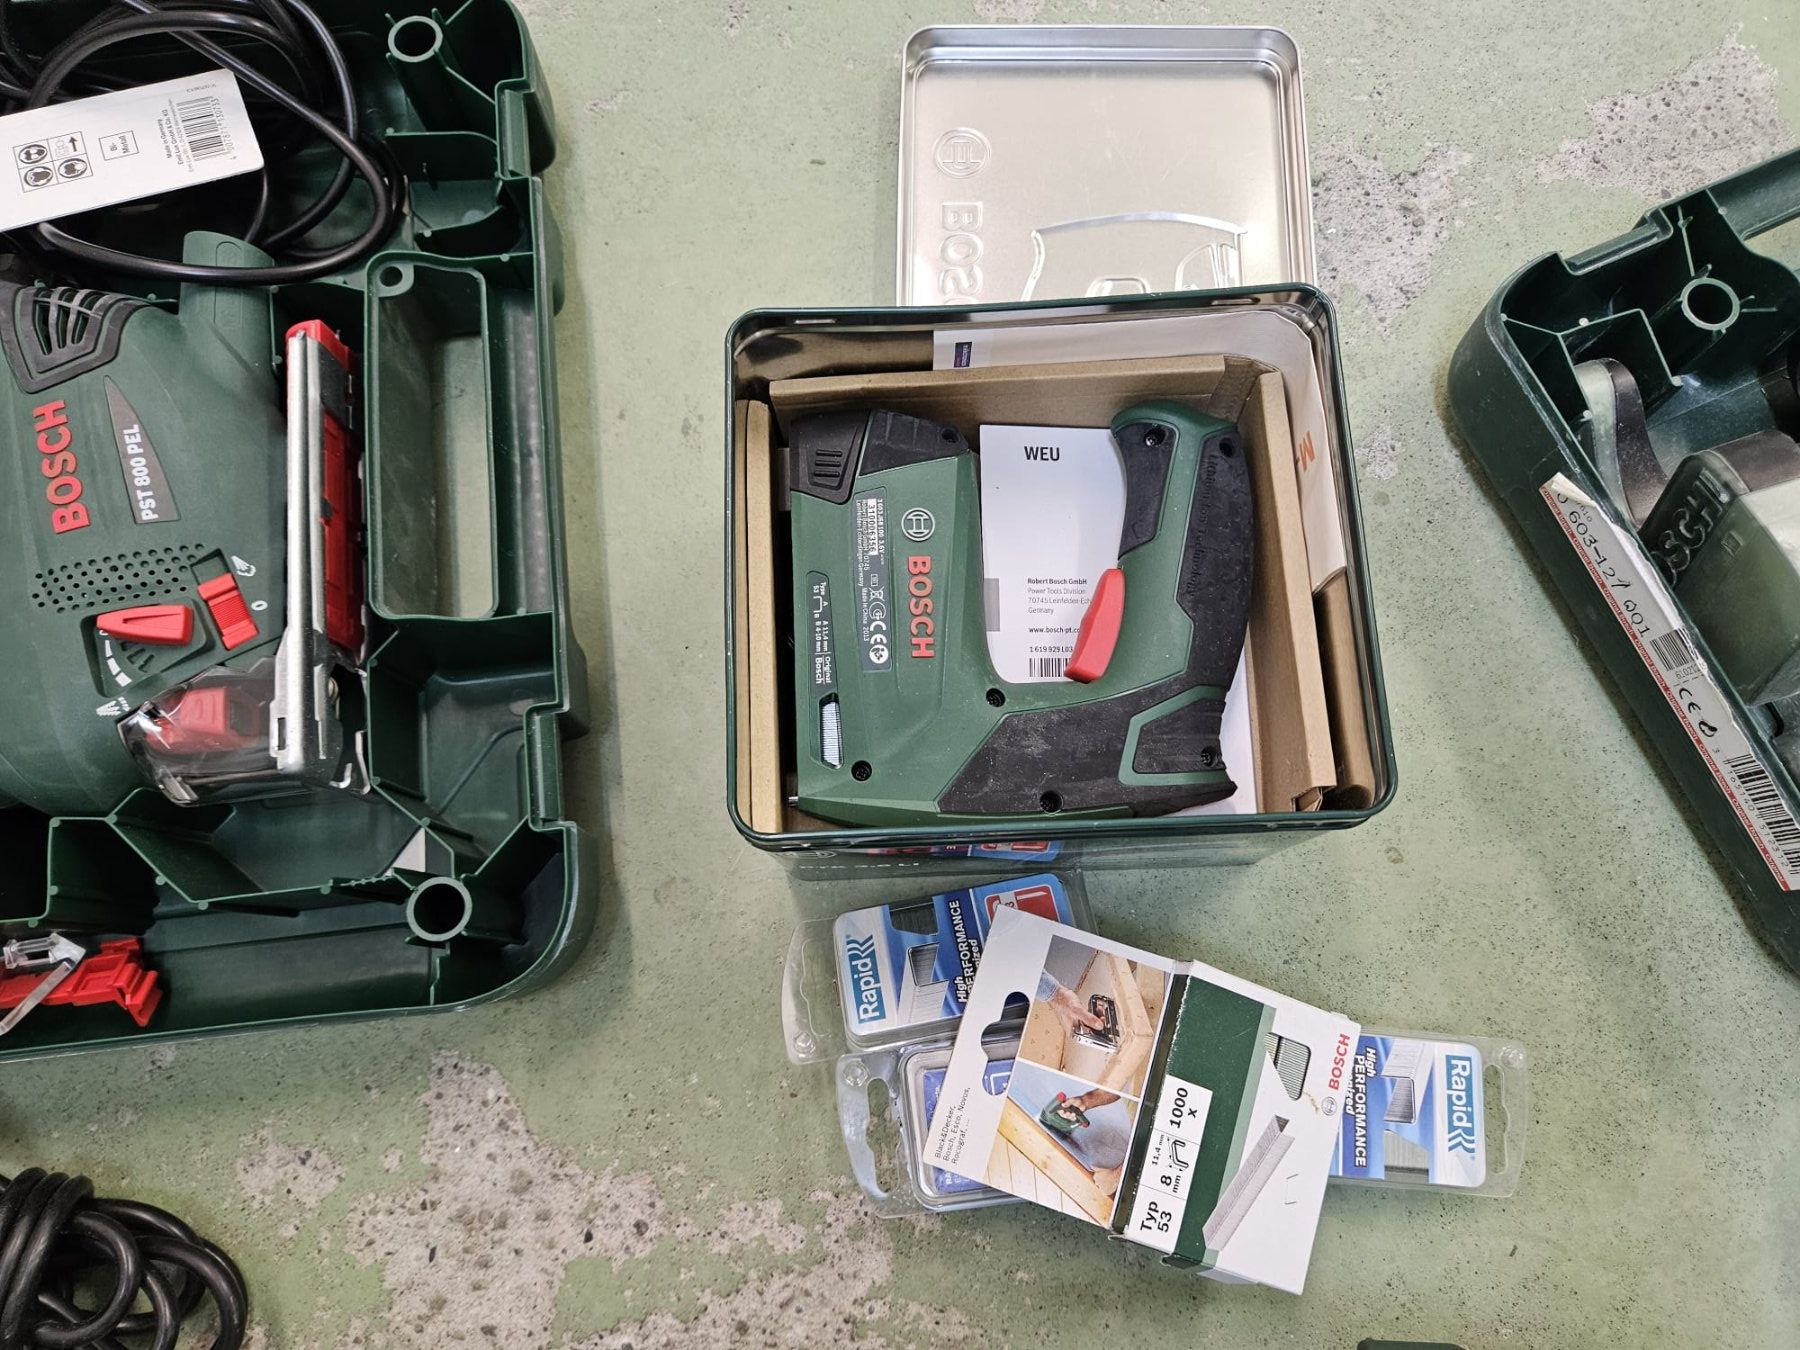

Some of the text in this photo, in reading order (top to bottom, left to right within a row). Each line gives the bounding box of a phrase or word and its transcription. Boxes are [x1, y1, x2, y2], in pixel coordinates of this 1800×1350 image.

[940, 201, 983, 305] BOS
[32, 400, 90, 534] BOSCH
[1024, 446, 1060, 461] WEU
[124, 424, 158, 521] PST 800 PEL
[908, 555, 936, 658] BOSCH
[1028, 607, 1054, 615] Germany
[1049, 597, 1092, 605] Leinfelden-Ech
[815, 657, 824, 684] Bosch
[822, 656, 831, 684] Original
[1727, 770, 1755, 812] 165140
[1759, 825, 1789, 868] 512312
[854, 953, 881, 1018] Rapid
[954, 976, 968, 1003] High
[1328, 1033, 1351, 1091] BOSCH
[1365, 1047, 1377, 1077] High
[1170, 1087, 1189, 1129] 1000
[1450, 1060, 1473, 1128] Rapid
[1188, 1108, 1198, 1119] x
[1353, 1054, 1368, 1167] PERFORMANCE
[943, 1137, 957, 1161] Bosch,
[1160, 1175, 1172, 1187] 8
[1172, 1175, 1181, 1193] mm
[1140, 1201, 1159, 1233] Typ
[1157, 1211, 1172, 1233] 53
